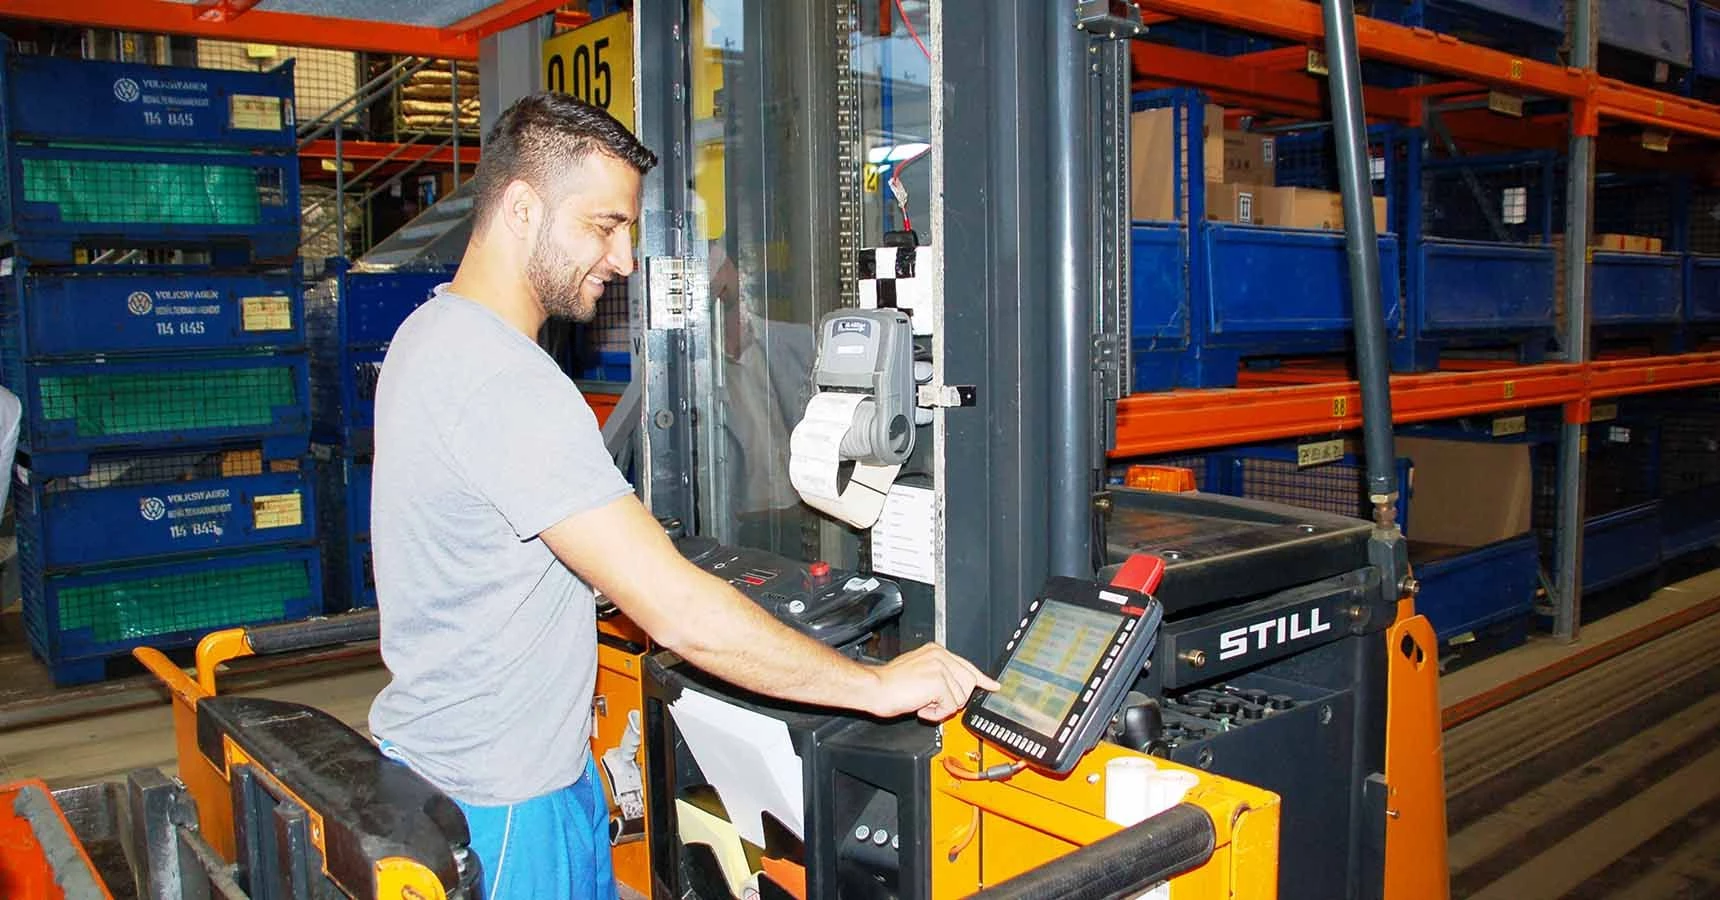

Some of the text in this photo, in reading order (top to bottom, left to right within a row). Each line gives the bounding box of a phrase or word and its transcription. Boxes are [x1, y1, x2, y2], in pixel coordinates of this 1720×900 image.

[143, 111, 162, 126] 114
[156, 321, 205, 336] 114 845
[1220, 607, 1331, 660] STILL
